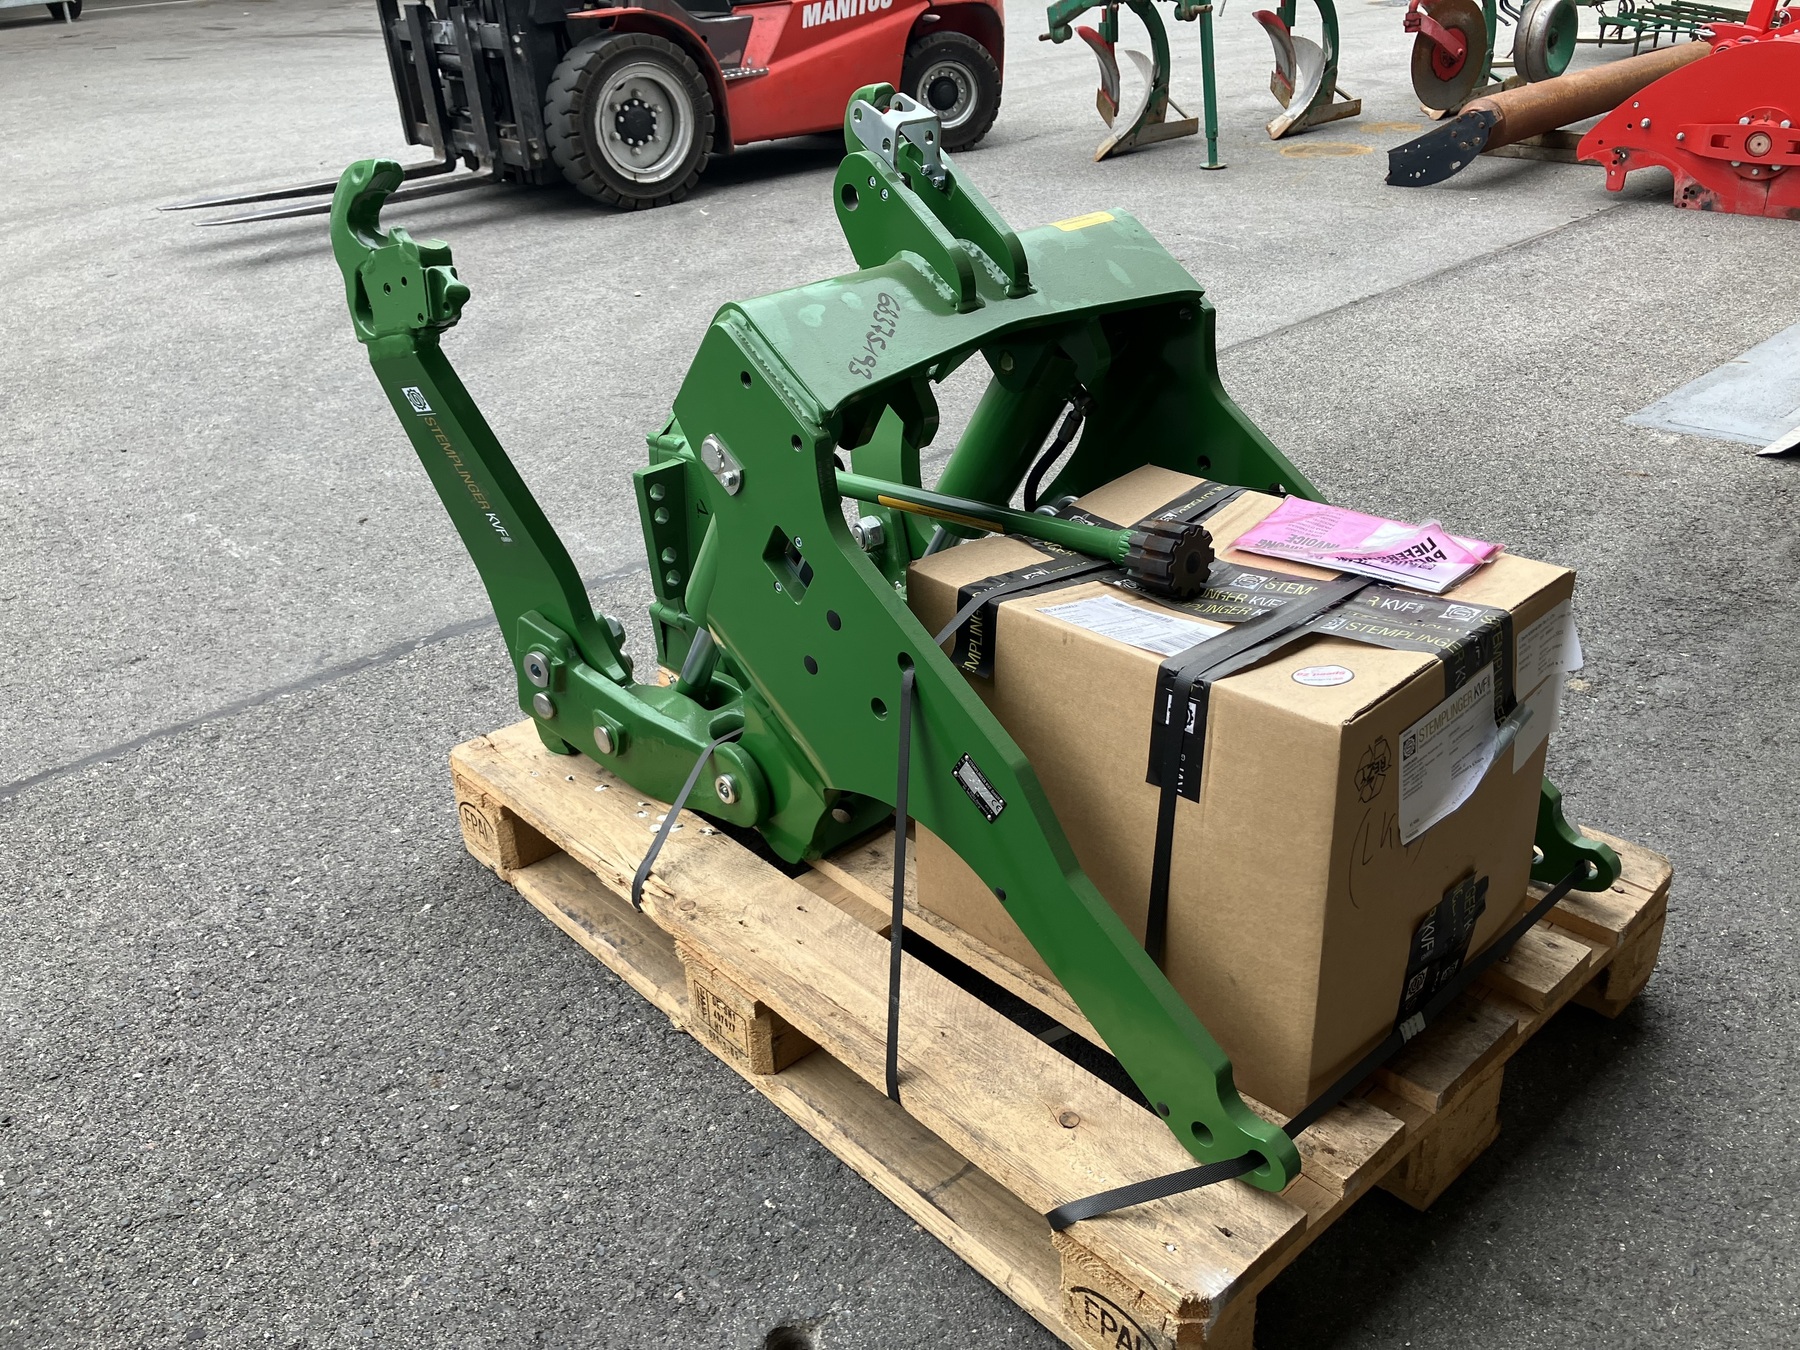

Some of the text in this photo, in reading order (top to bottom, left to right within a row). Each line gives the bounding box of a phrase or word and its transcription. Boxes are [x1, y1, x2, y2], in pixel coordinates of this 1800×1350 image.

[424, 416, 510, 537] STEMPLINGER KVF
[1381, 598, 1416, 612] KVF
[1345, 621, 1466, 664] STEMPLINGER
[1418, 687, 1475, 743] STEMPLINGER
